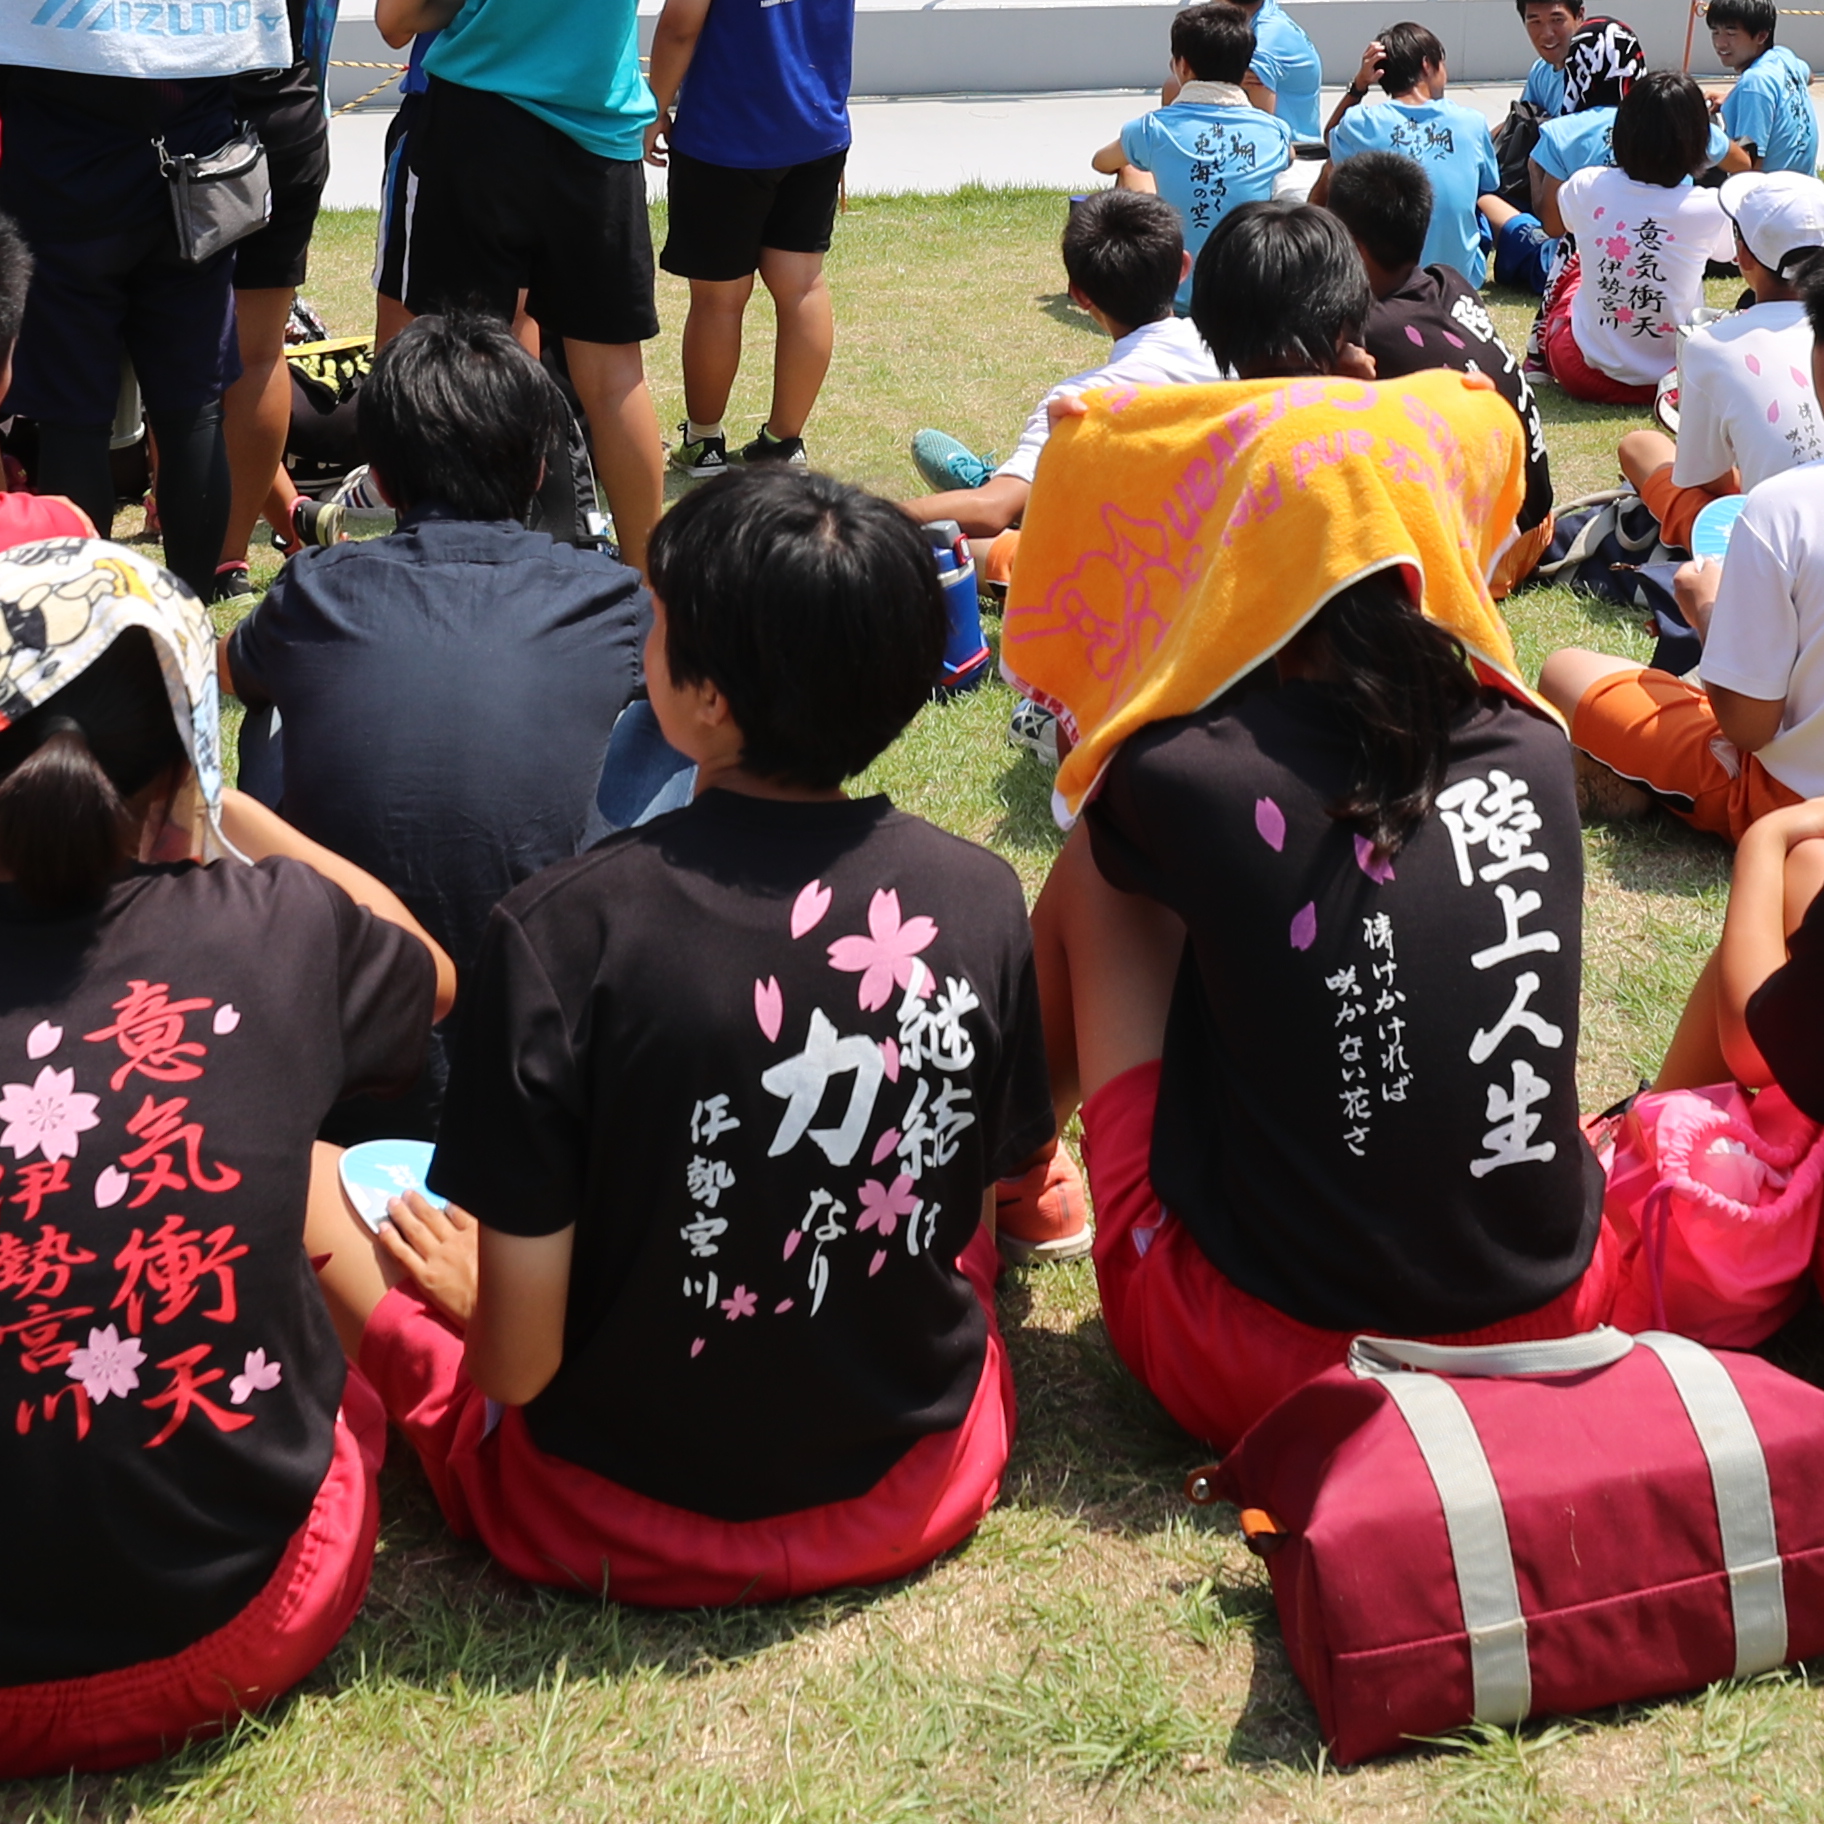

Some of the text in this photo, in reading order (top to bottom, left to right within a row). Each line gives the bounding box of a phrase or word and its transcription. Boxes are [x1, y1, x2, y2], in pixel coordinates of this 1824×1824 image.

[1189, 132, 1216, 229] 東海の空へ
[1596, 257, 1627, 331] 伊勢宮川
[1627, 217, 1670, 339] 意気衝天
[1434, 768, 1564, 1180] 陸上人生
[760, 1005, 887, 1170] 力
[892, 952, 982, 1261] 継続は
[82, 977, 255, 1452] 意気衝天
[679, 1092, 740, 1314] 伊勢宮川
[799, 1185, 850, 1321] なり
